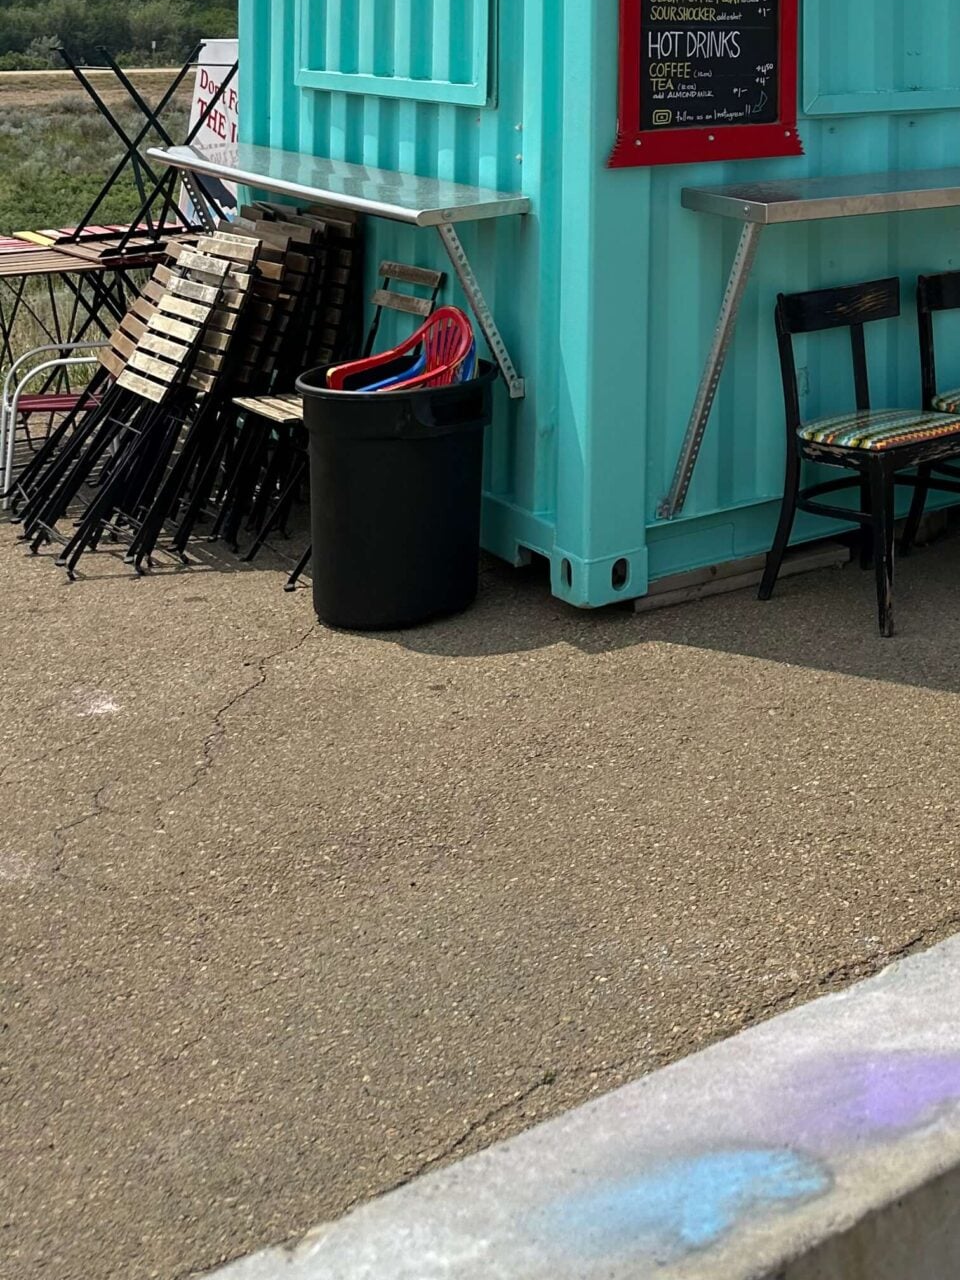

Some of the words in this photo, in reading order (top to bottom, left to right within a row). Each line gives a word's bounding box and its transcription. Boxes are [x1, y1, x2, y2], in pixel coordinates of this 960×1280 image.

[650, 5, 677, 21] SOUR
[678, 6, 717, 22] SHOCKER
[647, 30, 684, 59] HOT
[686, 30, 741, 58] DRINKS
[649, 62, 691, 78] COFFEE
[649, 78, 674, 91] TEA
[197, 97, 227, 140] THE
